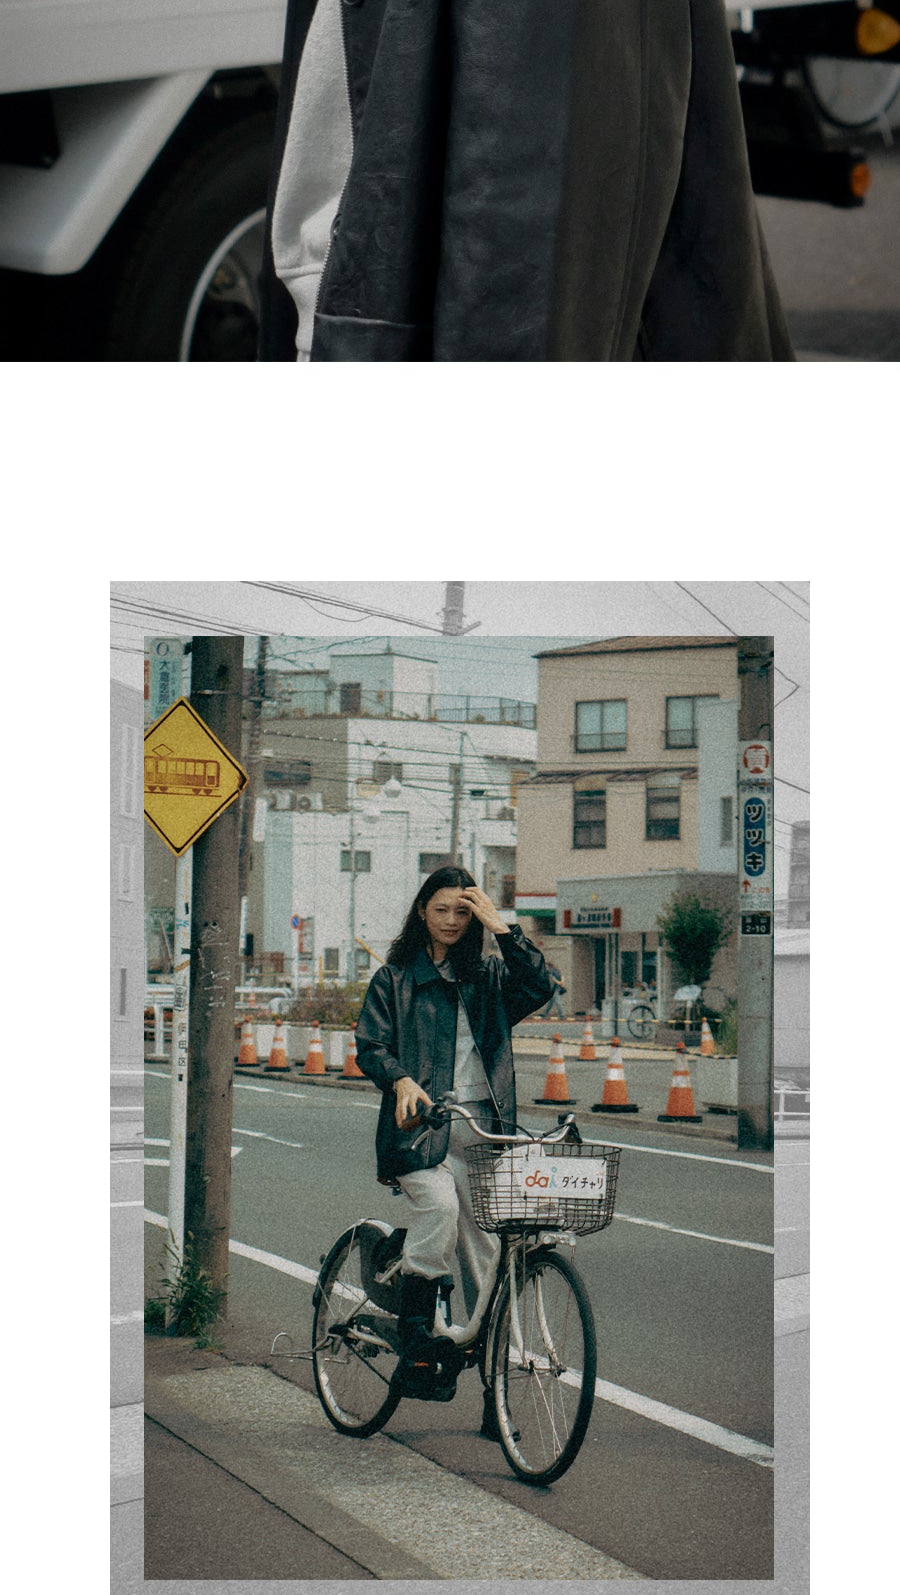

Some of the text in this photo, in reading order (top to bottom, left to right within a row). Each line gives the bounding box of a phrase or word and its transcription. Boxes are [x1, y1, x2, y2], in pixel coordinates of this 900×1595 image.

[525, 1166, 604, 1189] dai ダイチャリ
